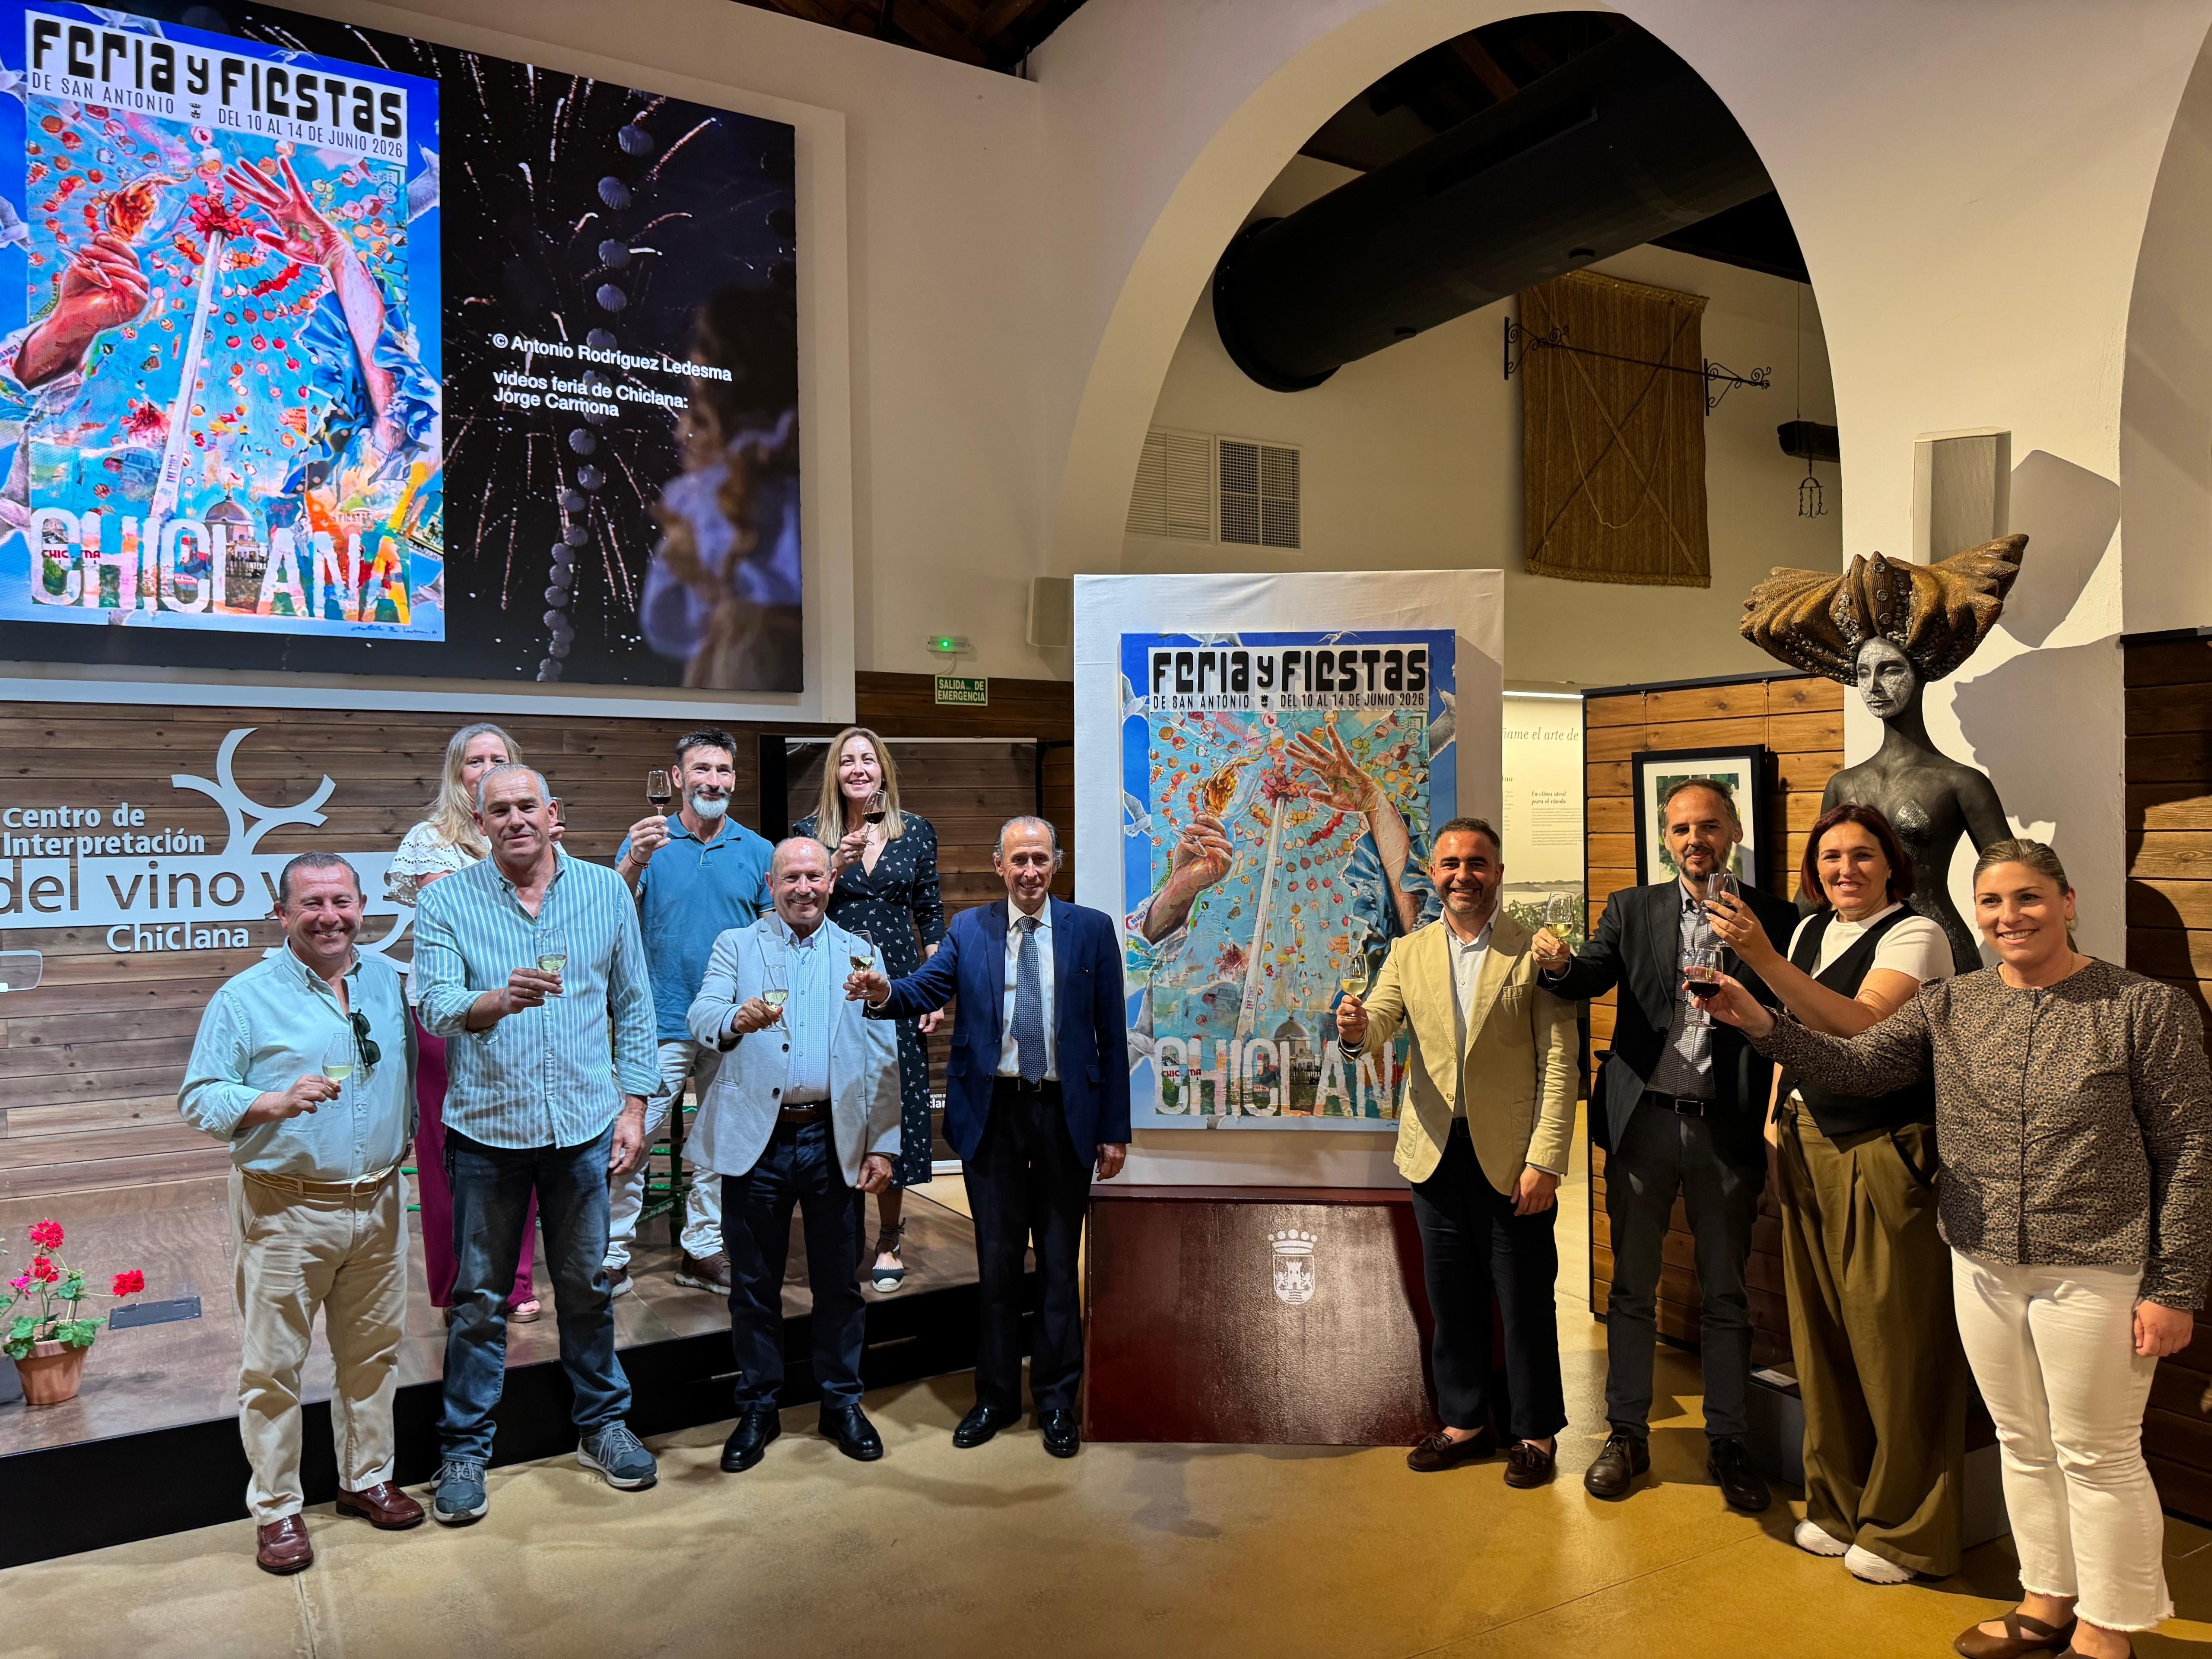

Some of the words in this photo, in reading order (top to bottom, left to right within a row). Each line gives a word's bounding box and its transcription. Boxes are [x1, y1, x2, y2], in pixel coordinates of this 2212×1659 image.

[187, 54, 209, 96] y
[32, 72, 51, 91] DE
[61, 78, 94, 100] SAN
[103, 86, 175, 115] ANTONIO
[218, 108, 242, 128] DEL
[247, 113, 262, 131] 10
[267, 117, 283, 136] AL
[288, 121, 303, 139] 14
[308, 126, 324, 143] DE
[328, 130, 367, 152] JUNIO
[373, 138, 403, 158] 2026
[511, 335, 573, 359] Antonio
[662, 356, 732, 382] Ledesma
[493, 387, 541, 409] Jorge
[545, 392, 620, 417] Carmona
[551, 376, 588, 396] feria
[591, 381, 612, 399] de
[616, 385, 689, 409] Chiclana:
[31, 507, 411, 625] CHICLANA
[939, 679, 965, 690] SALIDA
[974, 681, 984, 690] DE
[1257, 655, 1274, 688] y
[938, 690, 985, 702] EMERGENCIA
[1153, 695, 1166, 709] DE
[1172, 695, 1194, 709] SAN
[1200, 694, 1249, 709] ANTONIO
[1281, 693, 1297, 706] DEL
[1302, 694, 1313, 706] 10
[1315, 694, 1328, 706] AL
[1331, 693, 1344, 706] 14
[1348, 693, 1360, 706] DE
[1363, 693, 1395, 706] JUNIO
[1399, 693, 1424, 706] 2026
[1532, 727, 1541, 740] el
[1544, 729, 1564, 740] arte
[1567, 728, 1579, 741] de
[3, 805, 101, 829] Centro
[112, 802, 145, 827] de
[3, 827, 205, 858] Interpretación
[0, 858, 80, 913] del
[105, 860, 245, 910] vino
[106, 921, 249, 952] Chiclana
[1154, 1037, 1408, 1117] CHICLAN
